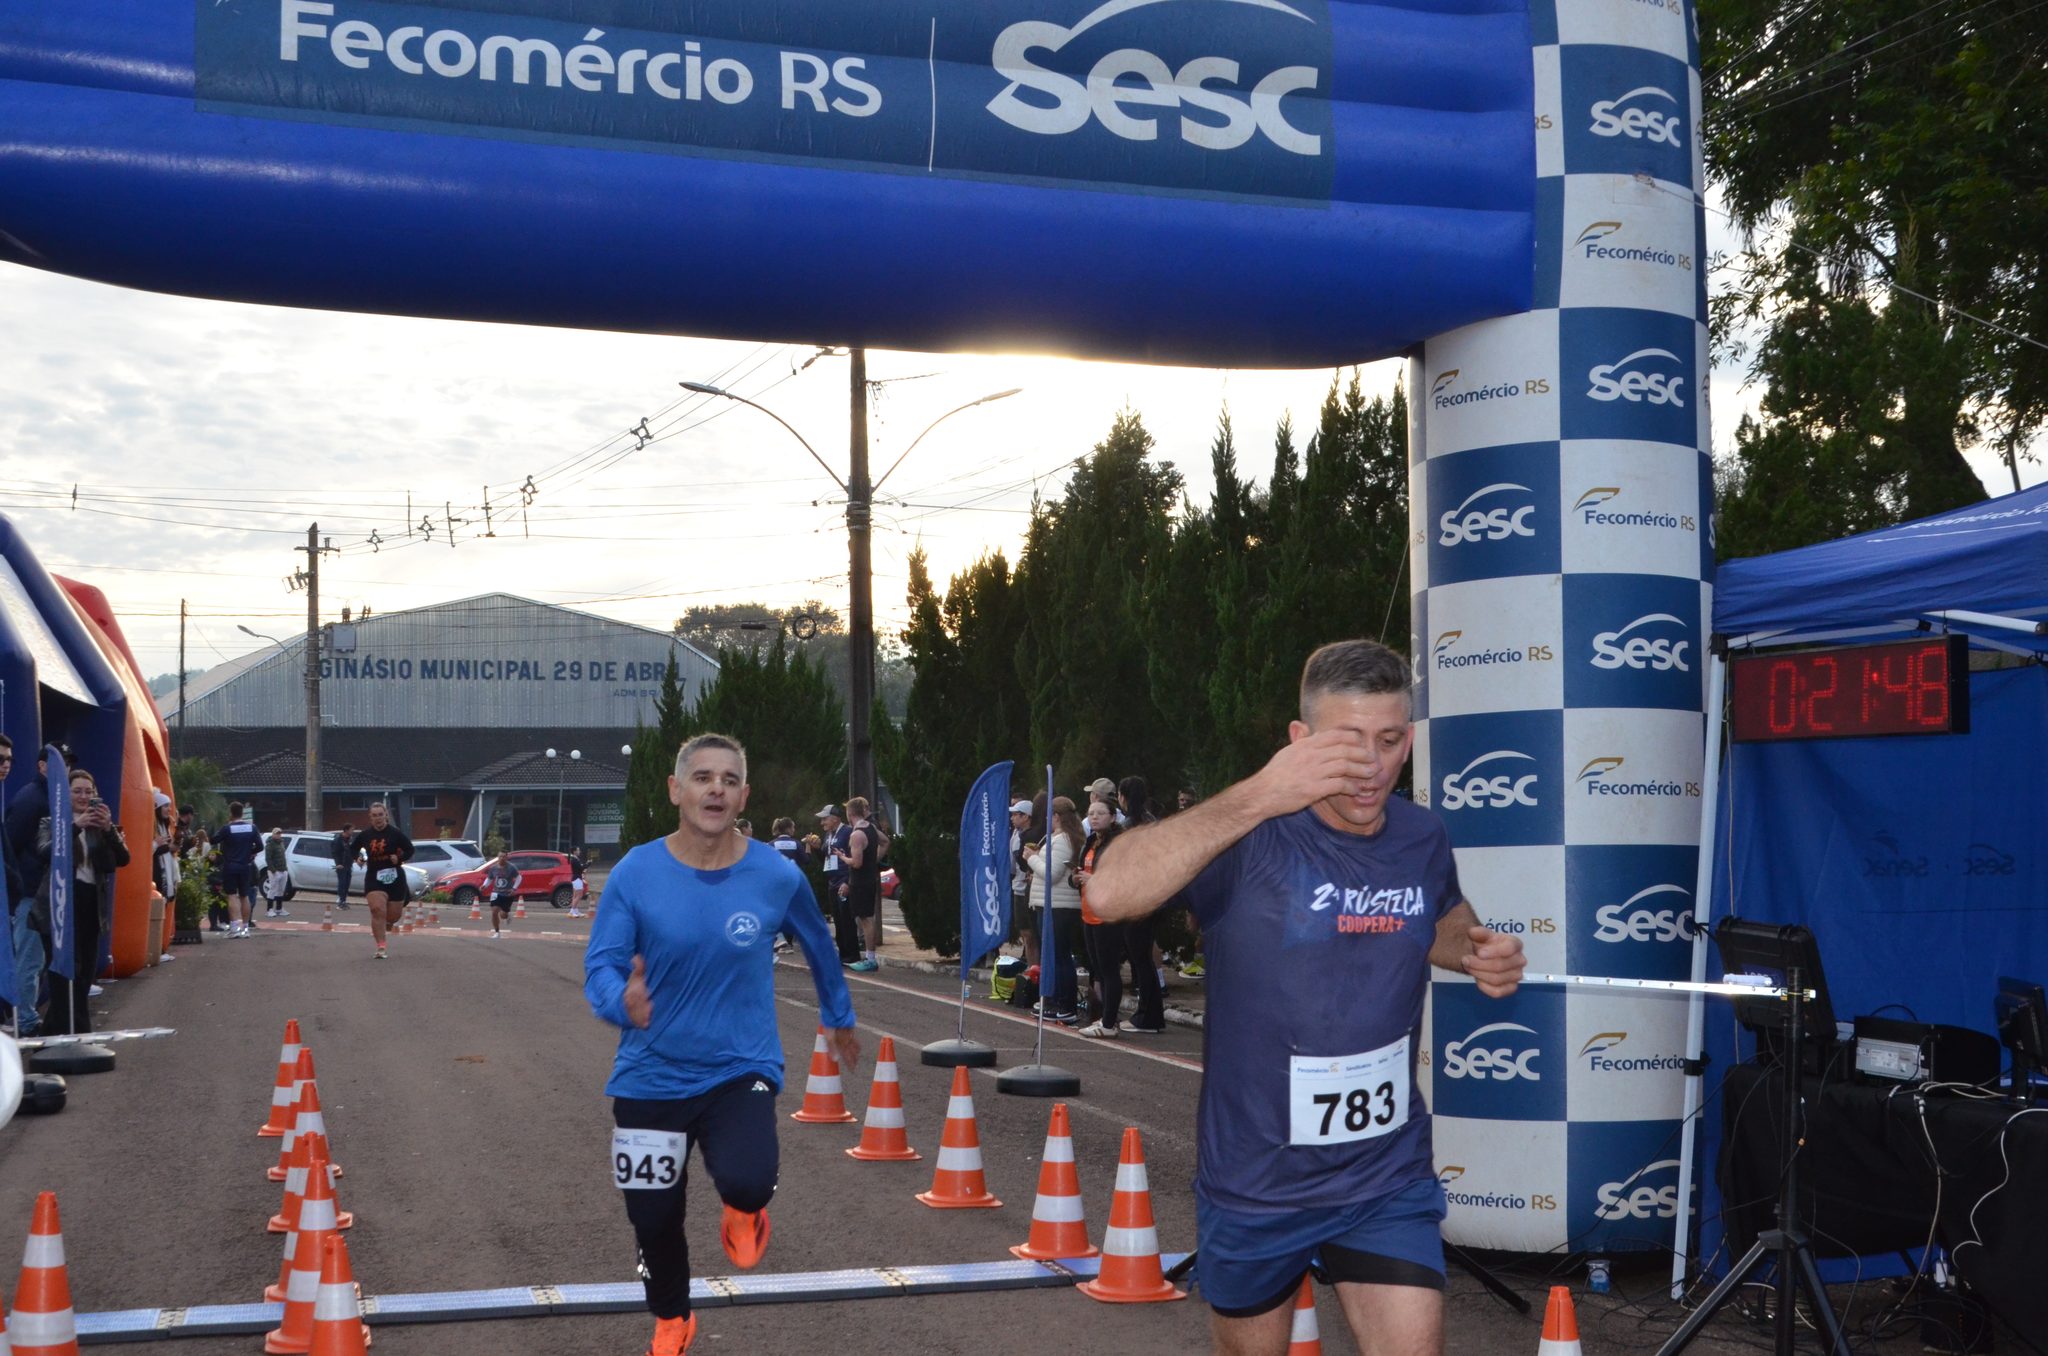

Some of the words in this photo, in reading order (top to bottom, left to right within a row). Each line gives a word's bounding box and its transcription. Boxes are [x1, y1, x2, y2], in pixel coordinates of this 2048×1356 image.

[279, 0, 754, 105] Fecomércio
[780, 50, 883, 118] RS
[985, 12, 1322, 156] Sesc
[1588, 99, 1681, 148] Sesc
[1586, 243, 1675, 266] Fecomércio
[1678, 253, 1692, 271] RS
[1435, 382, 1519, 410] Fecomércio
[1524, 378, 1550, 395] RS
[1586, 363, 1684, 408] Sesc
[1438, 505, 1536, 547] Sesc
[1584, 509, 1677, 528] Fecomércio
[1680, 514, 1696, 531] RS
[319, 654, 412, 681] GINÁSIO
[420, 659, 546, 681] MUNICIPAL
[553, 660, 582, 682] 29
[588, 661, 618, 682] DE
[624, 661, 687, 682] ABRL
[1437, 647, 1522, 670] Fecomércio
[1527, 645, 1553, 661] RS
[1590, 631, 1689, 672] Sesc
[1441, 773, 1538, 811] Sesc
[1588, 779, 1682, 797] Fecomércio
[1685, 782, 1701, 798] RS
[982, 791, 990, 857] Fecomércio
[983, 866, 1001, 937] Sesc
[1530, 918, 1556, 934] RS
[1443, 1041, 1540, 1081] Sesc
[1590, 1053, 1686, 1072] Fecomércio
[1312, 1080, 1396, 1137] 783
[615, 1152, 677, 1185] 943
[1531, 1194, 1557, 1211] RS
